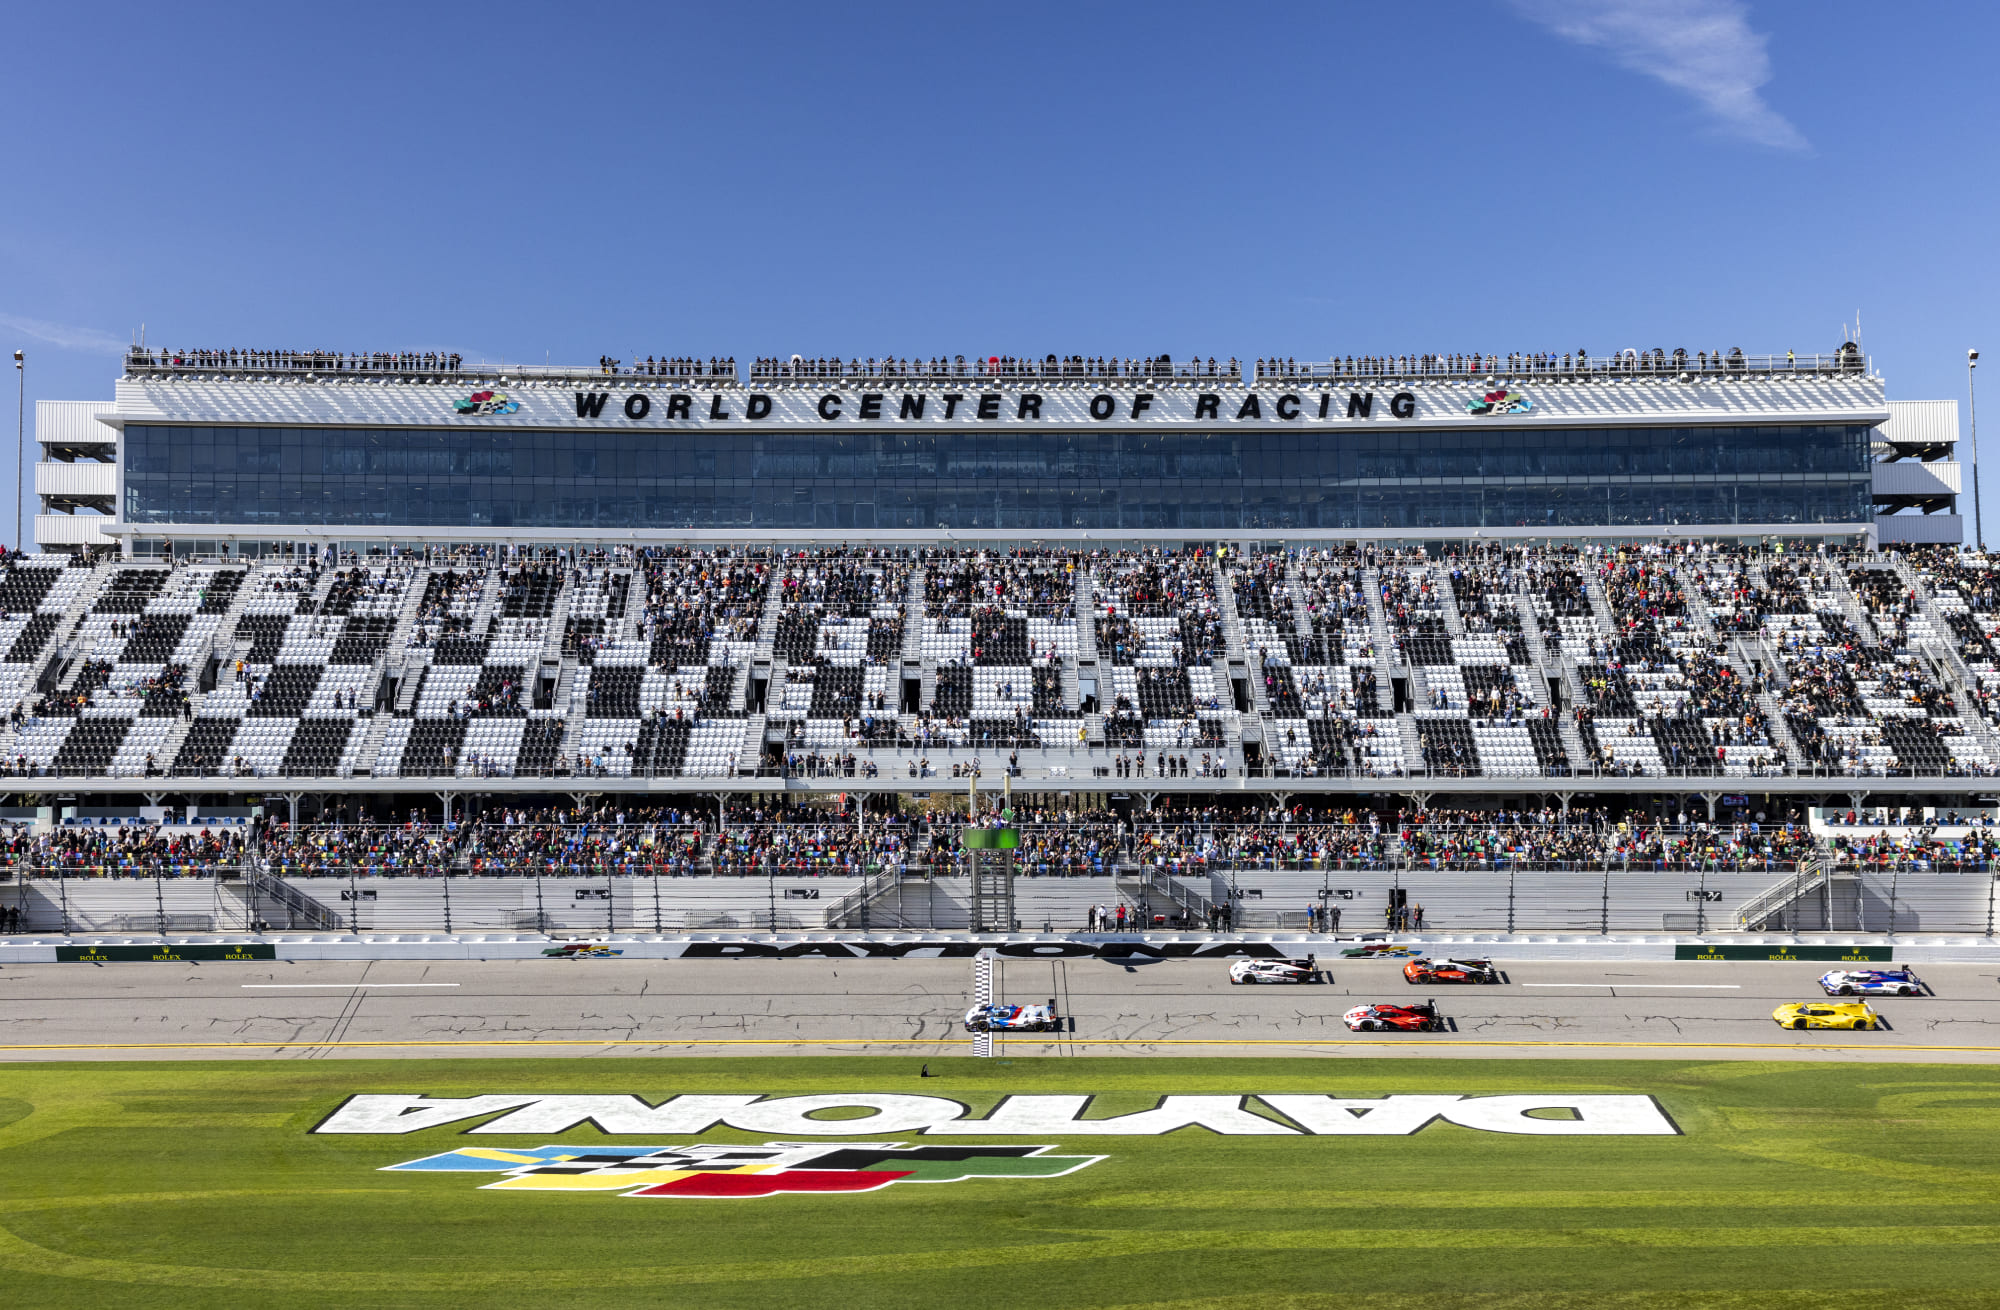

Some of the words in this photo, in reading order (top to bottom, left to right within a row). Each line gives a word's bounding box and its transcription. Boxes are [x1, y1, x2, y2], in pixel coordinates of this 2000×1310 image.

[576, 393, 771, 420] WORLD
[818, 393, 1042, 420] CENTER
[1090, 394, 1153, 420] OF
[1196, 393, 1415, 420] RACING
[680, 943, 1286, 958] DAYTONA
[306, 1093, 1685, 1136] DAYTONA
